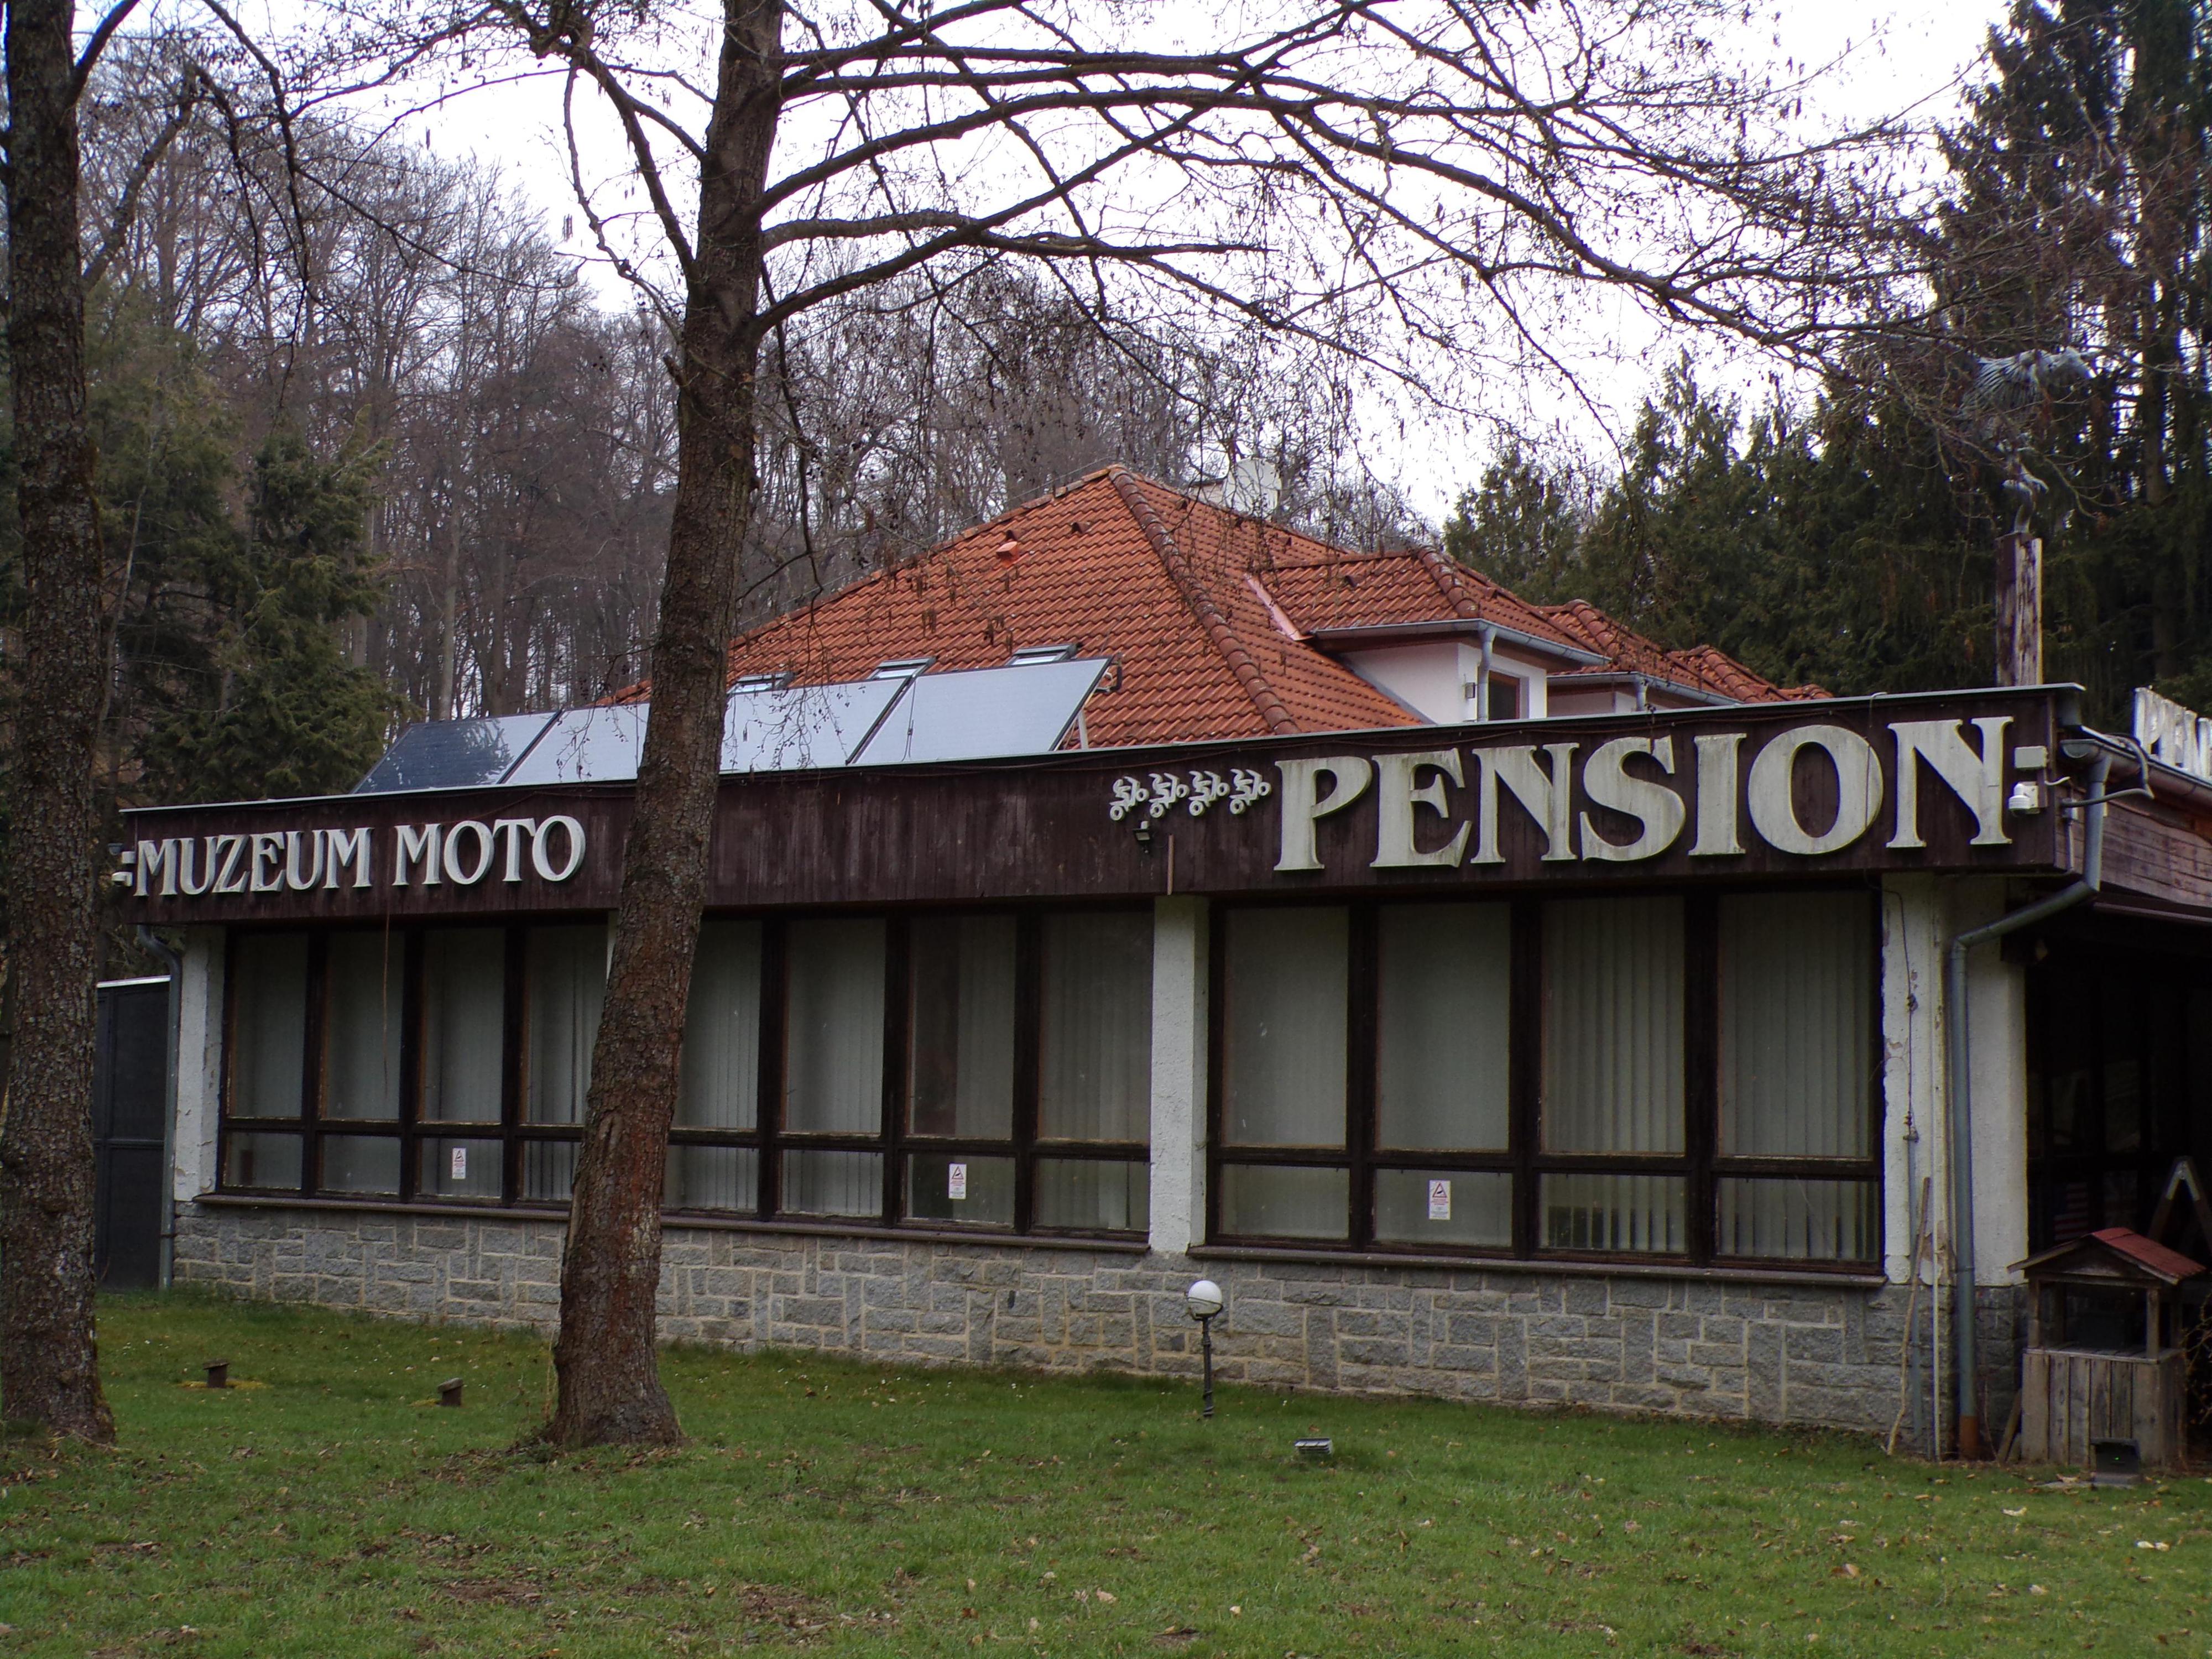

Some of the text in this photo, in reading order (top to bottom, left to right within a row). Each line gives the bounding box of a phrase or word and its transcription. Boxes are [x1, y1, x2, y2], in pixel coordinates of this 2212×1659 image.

[1273, 716, 2014, 872] PENSION
[133, 815, 587, 897] MUZEUM MOTO
